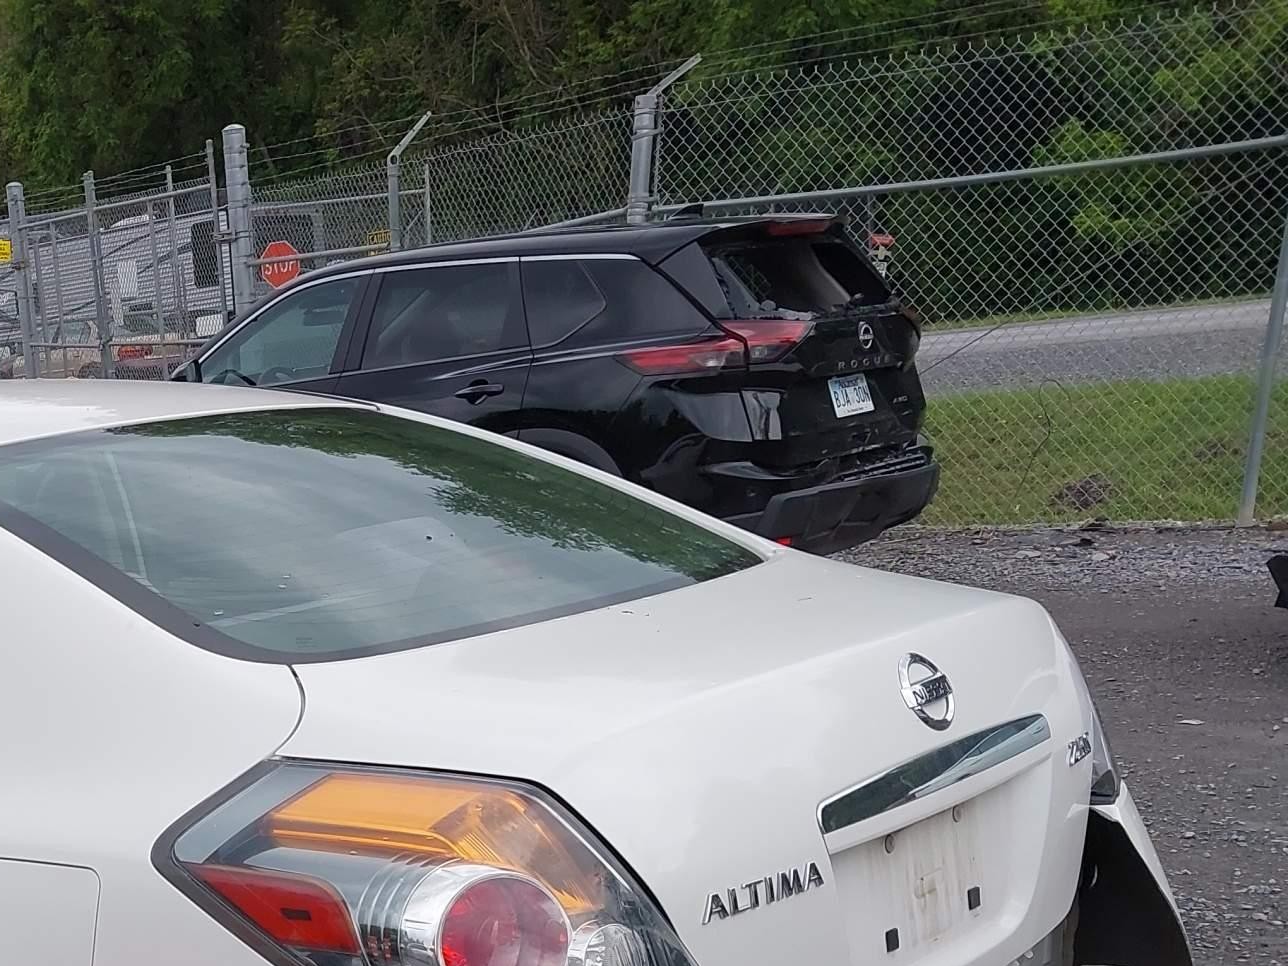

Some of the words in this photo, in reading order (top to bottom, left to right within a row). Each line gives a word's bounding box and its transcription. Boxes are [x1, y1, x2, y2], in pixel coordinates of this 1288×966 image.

[369, 232, 392, 244] CAUTIO
[264, 260, 296, 275] STOP
[701, 861, 824, 925] ALTIMA
